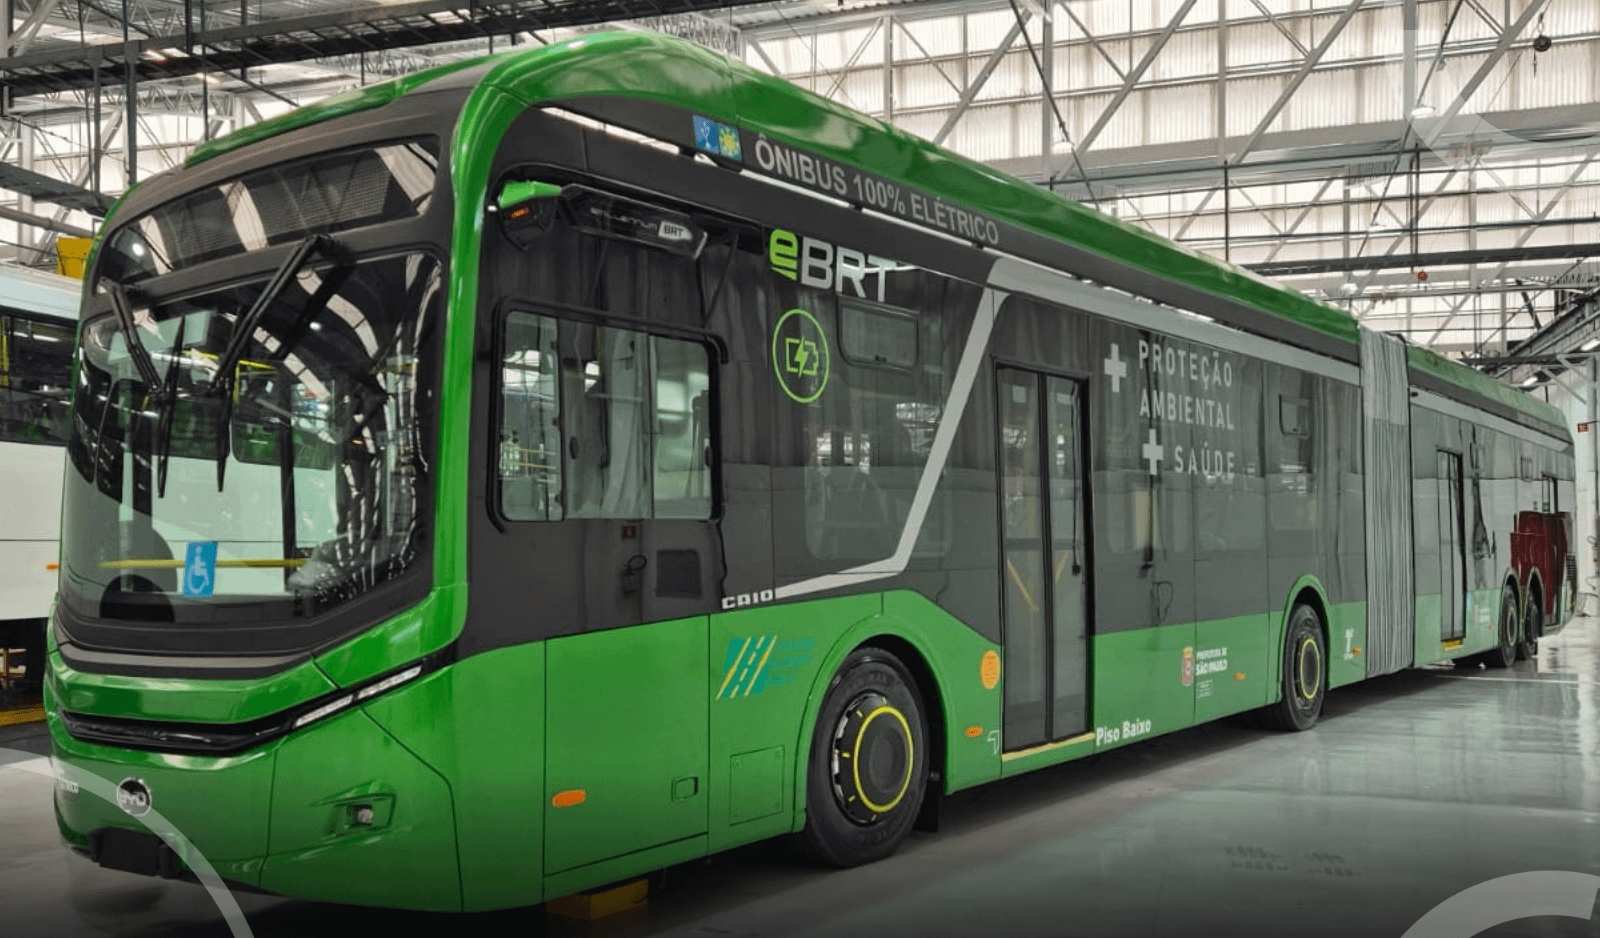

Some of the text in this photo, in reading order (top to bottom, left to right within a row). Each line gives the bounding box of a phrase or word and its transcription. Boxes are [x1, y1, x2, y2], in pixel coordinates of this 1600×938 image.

[755, 132, 1000, 246] ÔNIBUS 100% ELÉTRICO
[664, 224, 684, 236] BRT
[1138, 339, 1233, 390] PROTEÇÃO
[1140, 388, 1235, 431] AMBIENTAL
[1174, 441, 1235, 479] SAÚDE
[721, 589, 774, 610] CAIO
[1096, 718, 1151, 746] Piso Baixo
